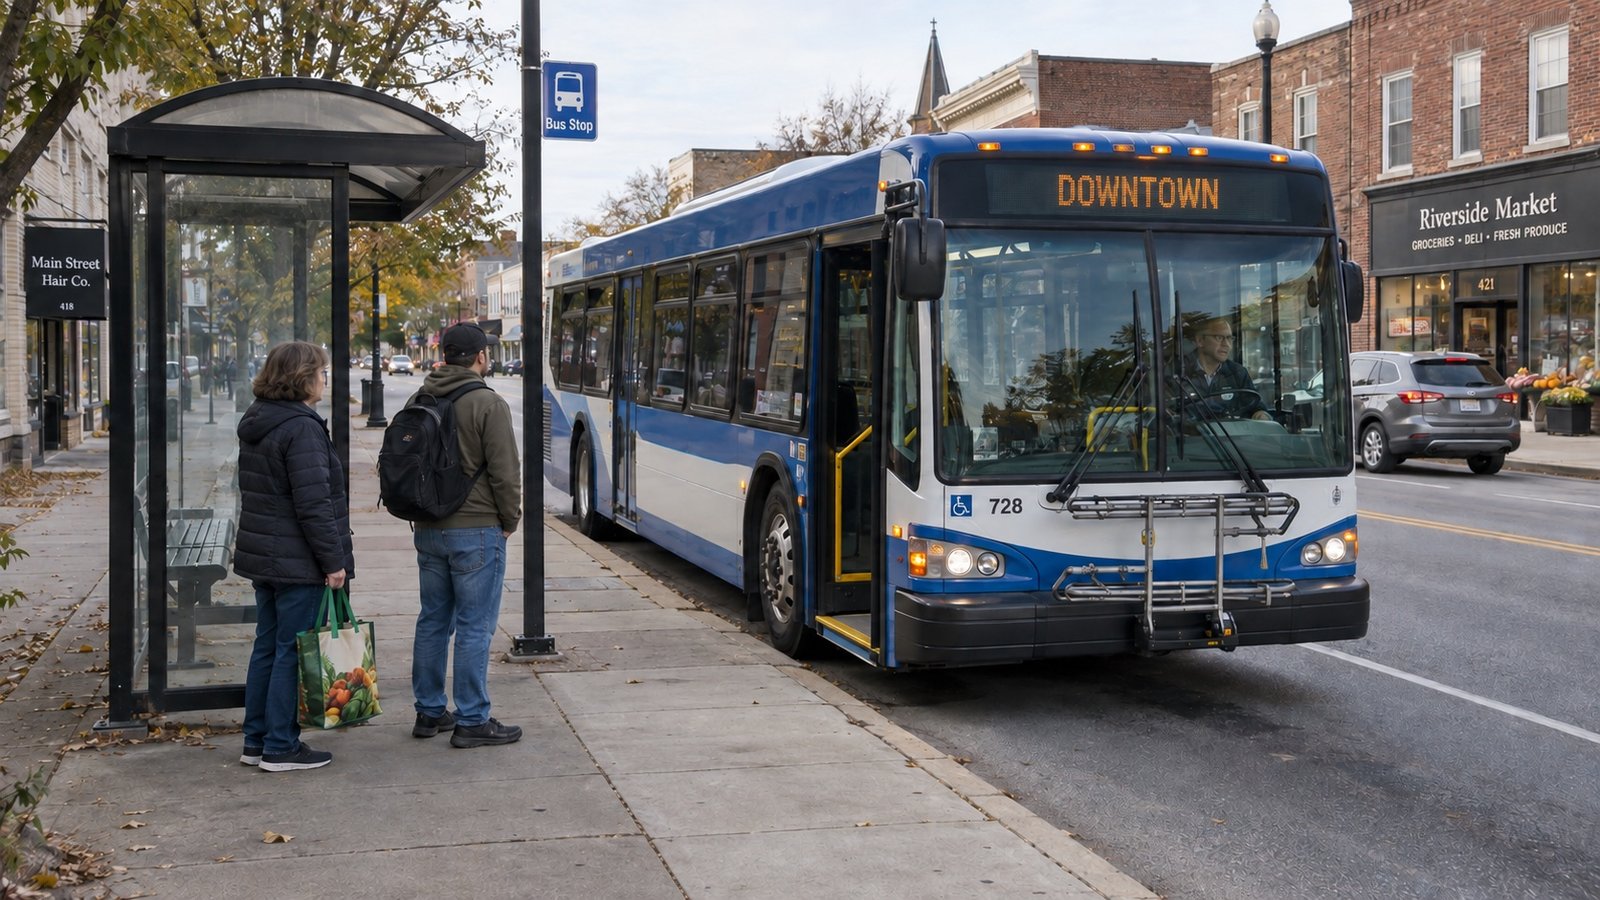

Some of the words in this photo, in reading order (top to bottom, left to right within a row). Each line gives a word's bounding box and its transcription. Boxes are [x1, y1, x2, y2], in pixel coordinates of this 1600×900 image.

[546, 117, 567, 130] Bus
[569, 118, 594, 134] Stop
[1058, 174, 1219, 210] DOWNTOWN
[1419, 200, 1489, 231] Riverside
[1495, 192, 1558, 220] Market
[1411, 235, 1455, 251] GROCERIES
[1464, 232, 1483, 246] DELI
[1493, 228, 1521, 242] FRESH
[1524, 222, 1568, 239] PRODUCE
[31, 255, 63, 269] Main
[65, 256, 101, 270] Street
[42, 274, 68, 287] Hair
[71, 275, 91, 287] Co.
[1477, 277, 1495, 291] 421
[59, 302, 74, 311] 418
[989, 498, 1023, 515] 728
